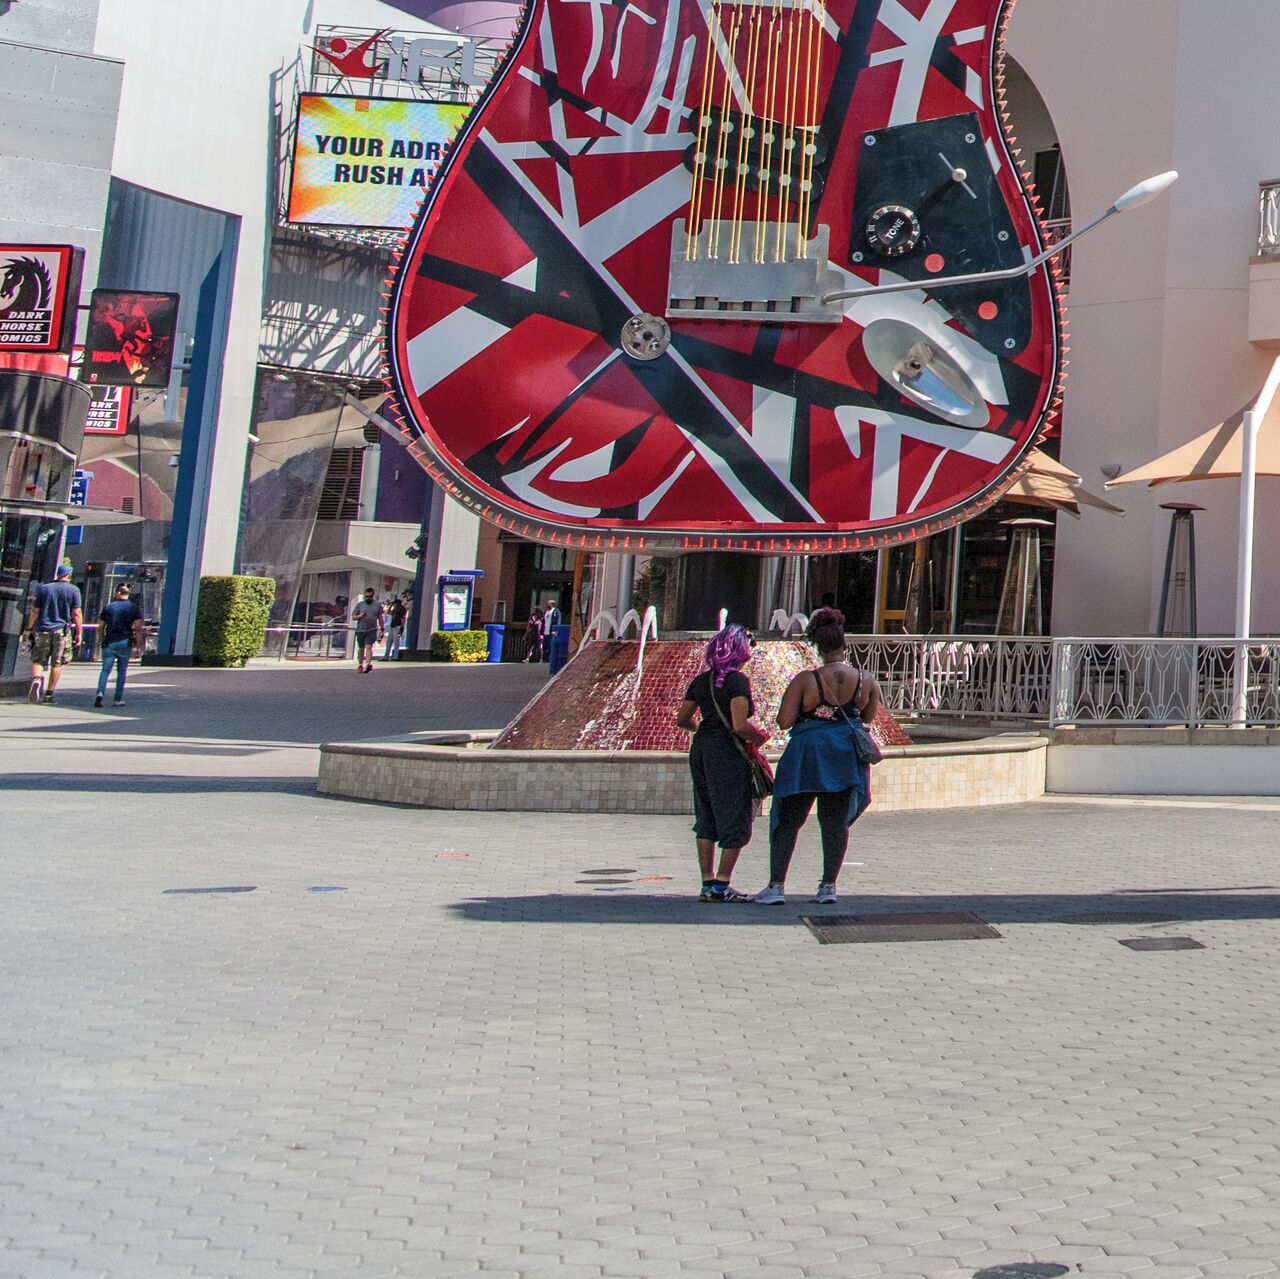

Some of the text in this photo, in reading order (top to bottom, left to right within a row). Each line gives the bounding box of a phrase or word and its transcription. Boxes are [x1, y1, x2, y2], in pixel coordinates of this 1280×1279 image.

[315, 135, 450, 160] YOUR ADR
[334, 164, 435, 187] RUSH A
[885, 218, 905, 239] TONE
[9, 312, 45, 320] DARK
[0, 323, 43, 331] HORSE
[0, 334, 42, 342] OMICS
